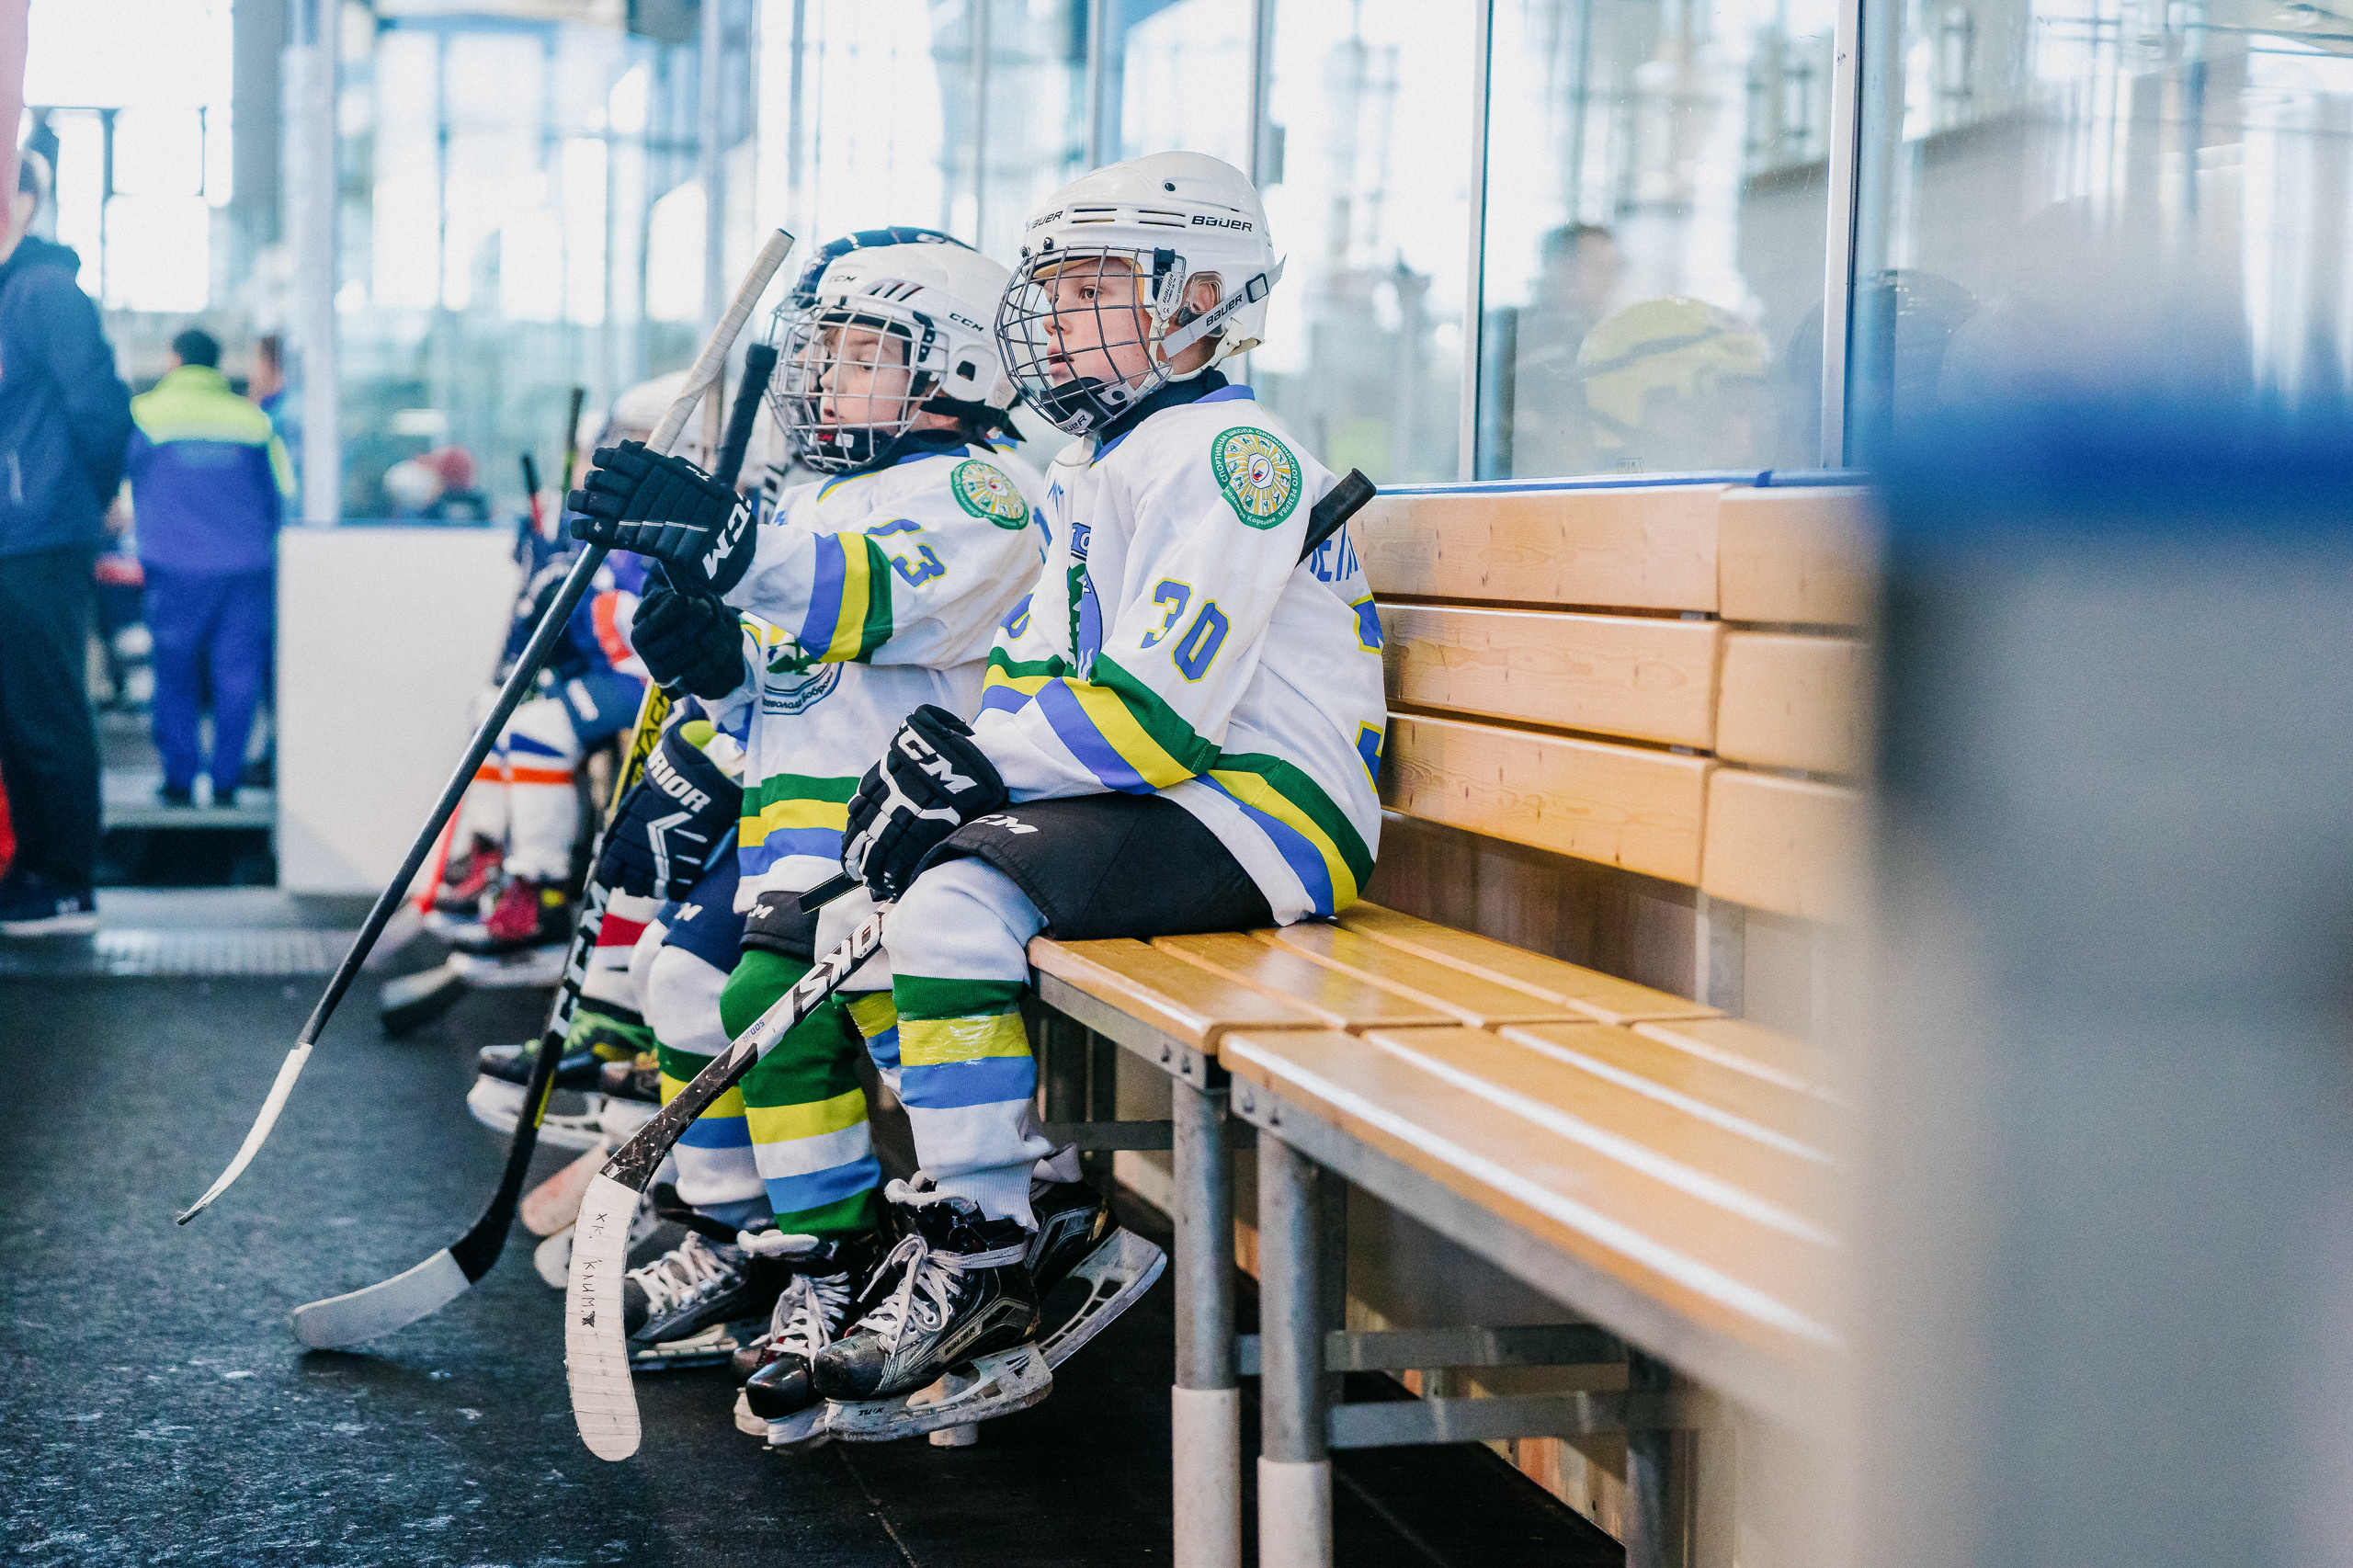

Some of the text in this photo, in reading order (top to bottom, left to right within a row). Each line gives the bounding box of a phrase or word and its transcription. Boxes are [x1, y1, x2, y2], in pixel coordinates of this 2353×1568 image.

[1191, 215, 1253, 232] BAUER
[949, 312, 984, 332] CCM
[1206, 293, 1243, 326] BAUER
[1062, 414, 1087, 433] UER
[1214, 434, 1229, 483] СПОРТИВНАЯ
[1226, 427, 1255, 437] ШКОЛА
[1278, 488, 1298, 518] РЕЗЕРВА
[702, 492, 753, 581] CM
[1138, 577, 1232, 684] 30
[898, 719, 979, 795] CM
